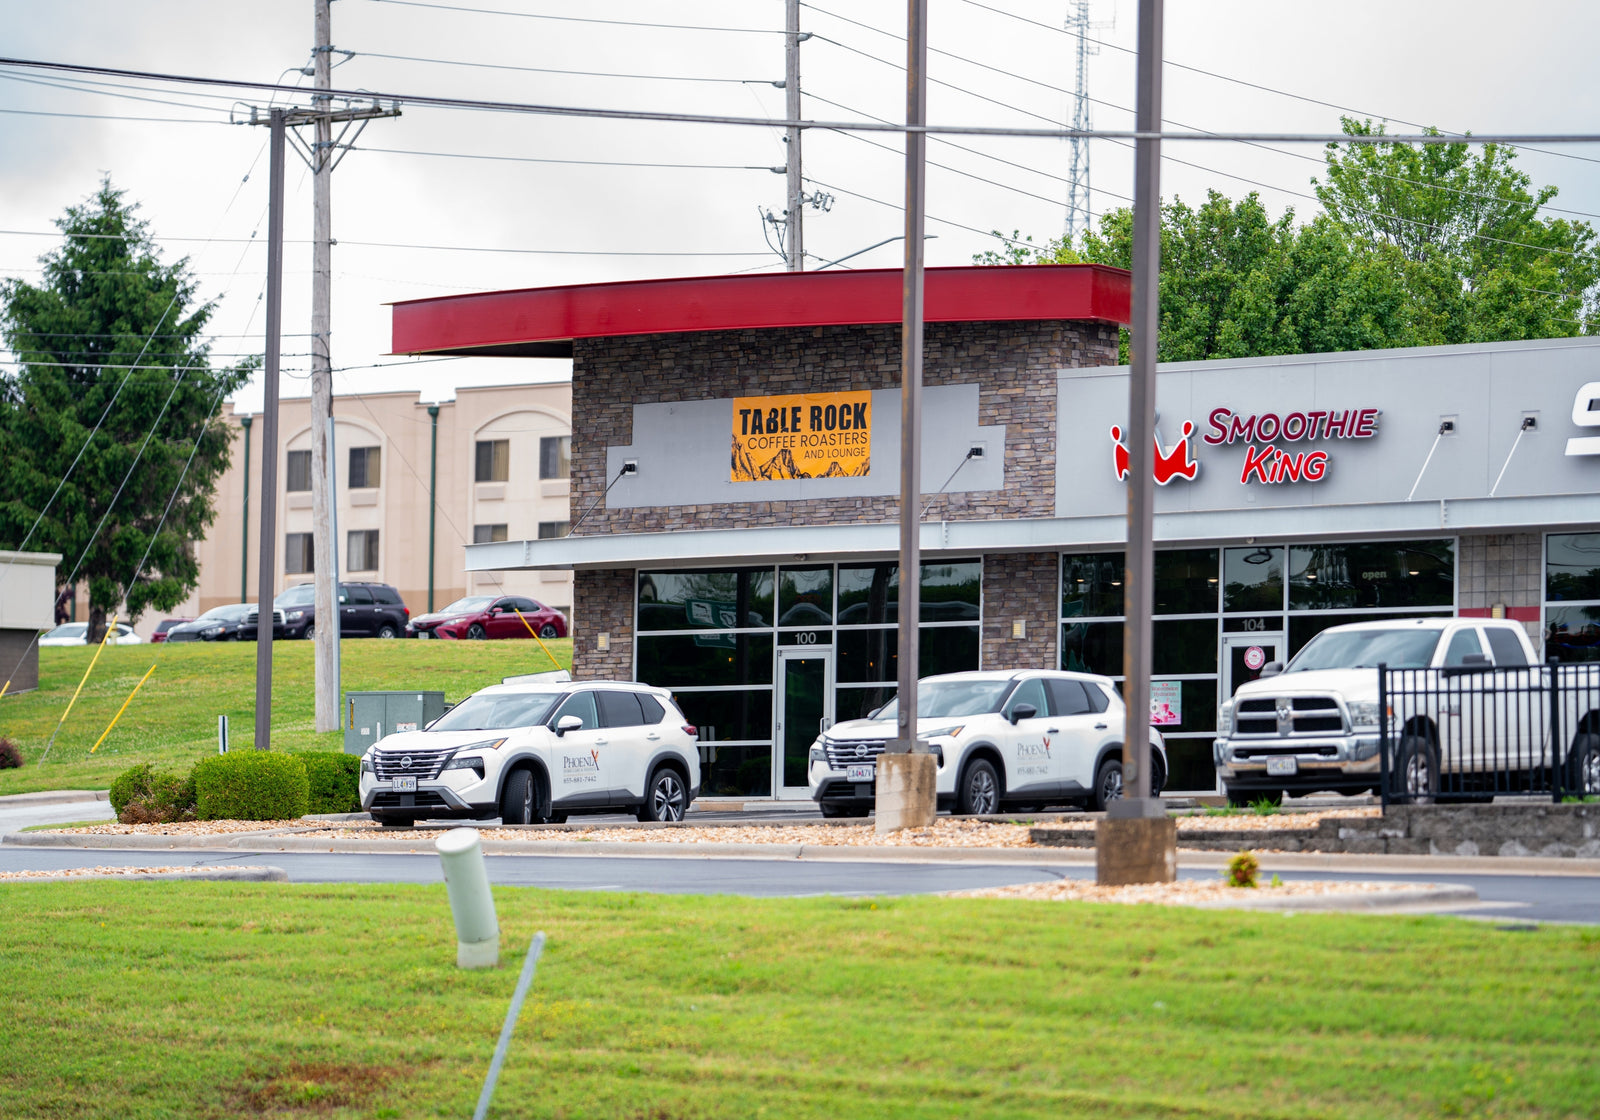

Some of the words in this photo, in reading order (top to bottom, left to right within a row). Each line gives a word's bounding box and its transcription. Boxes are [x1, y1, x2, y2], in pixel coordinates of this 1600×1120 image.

[739, 406, 802, 435] TABLE
[809, 402, 868, 432] ROCK
[1202, 406, 1379, 446] SMOOTHIE
[747, 435, 796, 450] COFFEE
[800, 431, 868, 448] ROASTERS
[804, 449, 825, 459] AND
[827, 447, 866, 458] LOUNGE
[1361, 570, 1388, 581] open
[1241, 618, 1266, 631] 104
[794, 631, 817, 645] 100
[563, 749, 600, 770] PHOENIX
